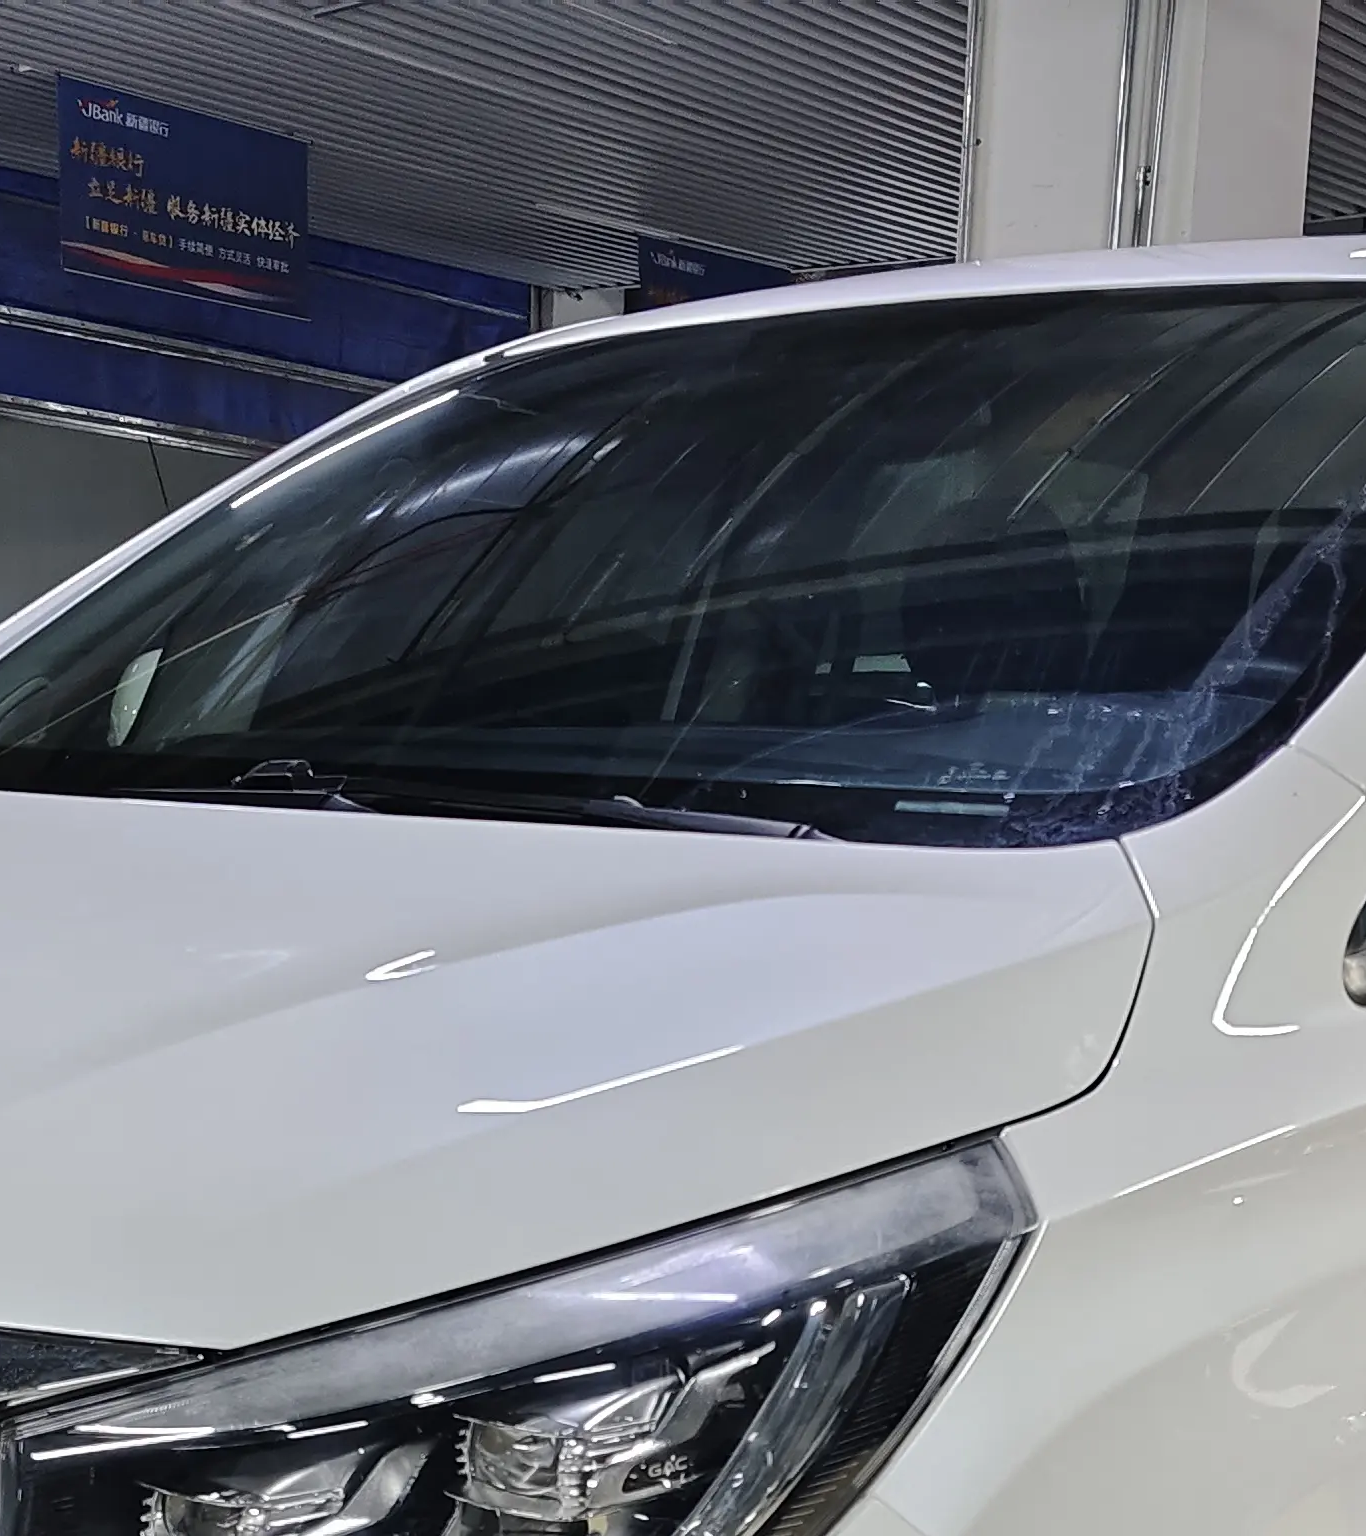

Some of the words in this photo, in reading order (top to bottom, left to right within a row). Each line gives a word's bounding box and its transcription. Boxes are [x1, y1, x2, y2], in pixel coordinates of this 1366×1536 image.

[167, 195, 300, 249] 服务新疆实体经济
[647, 1456, 688, 1478] GAC
